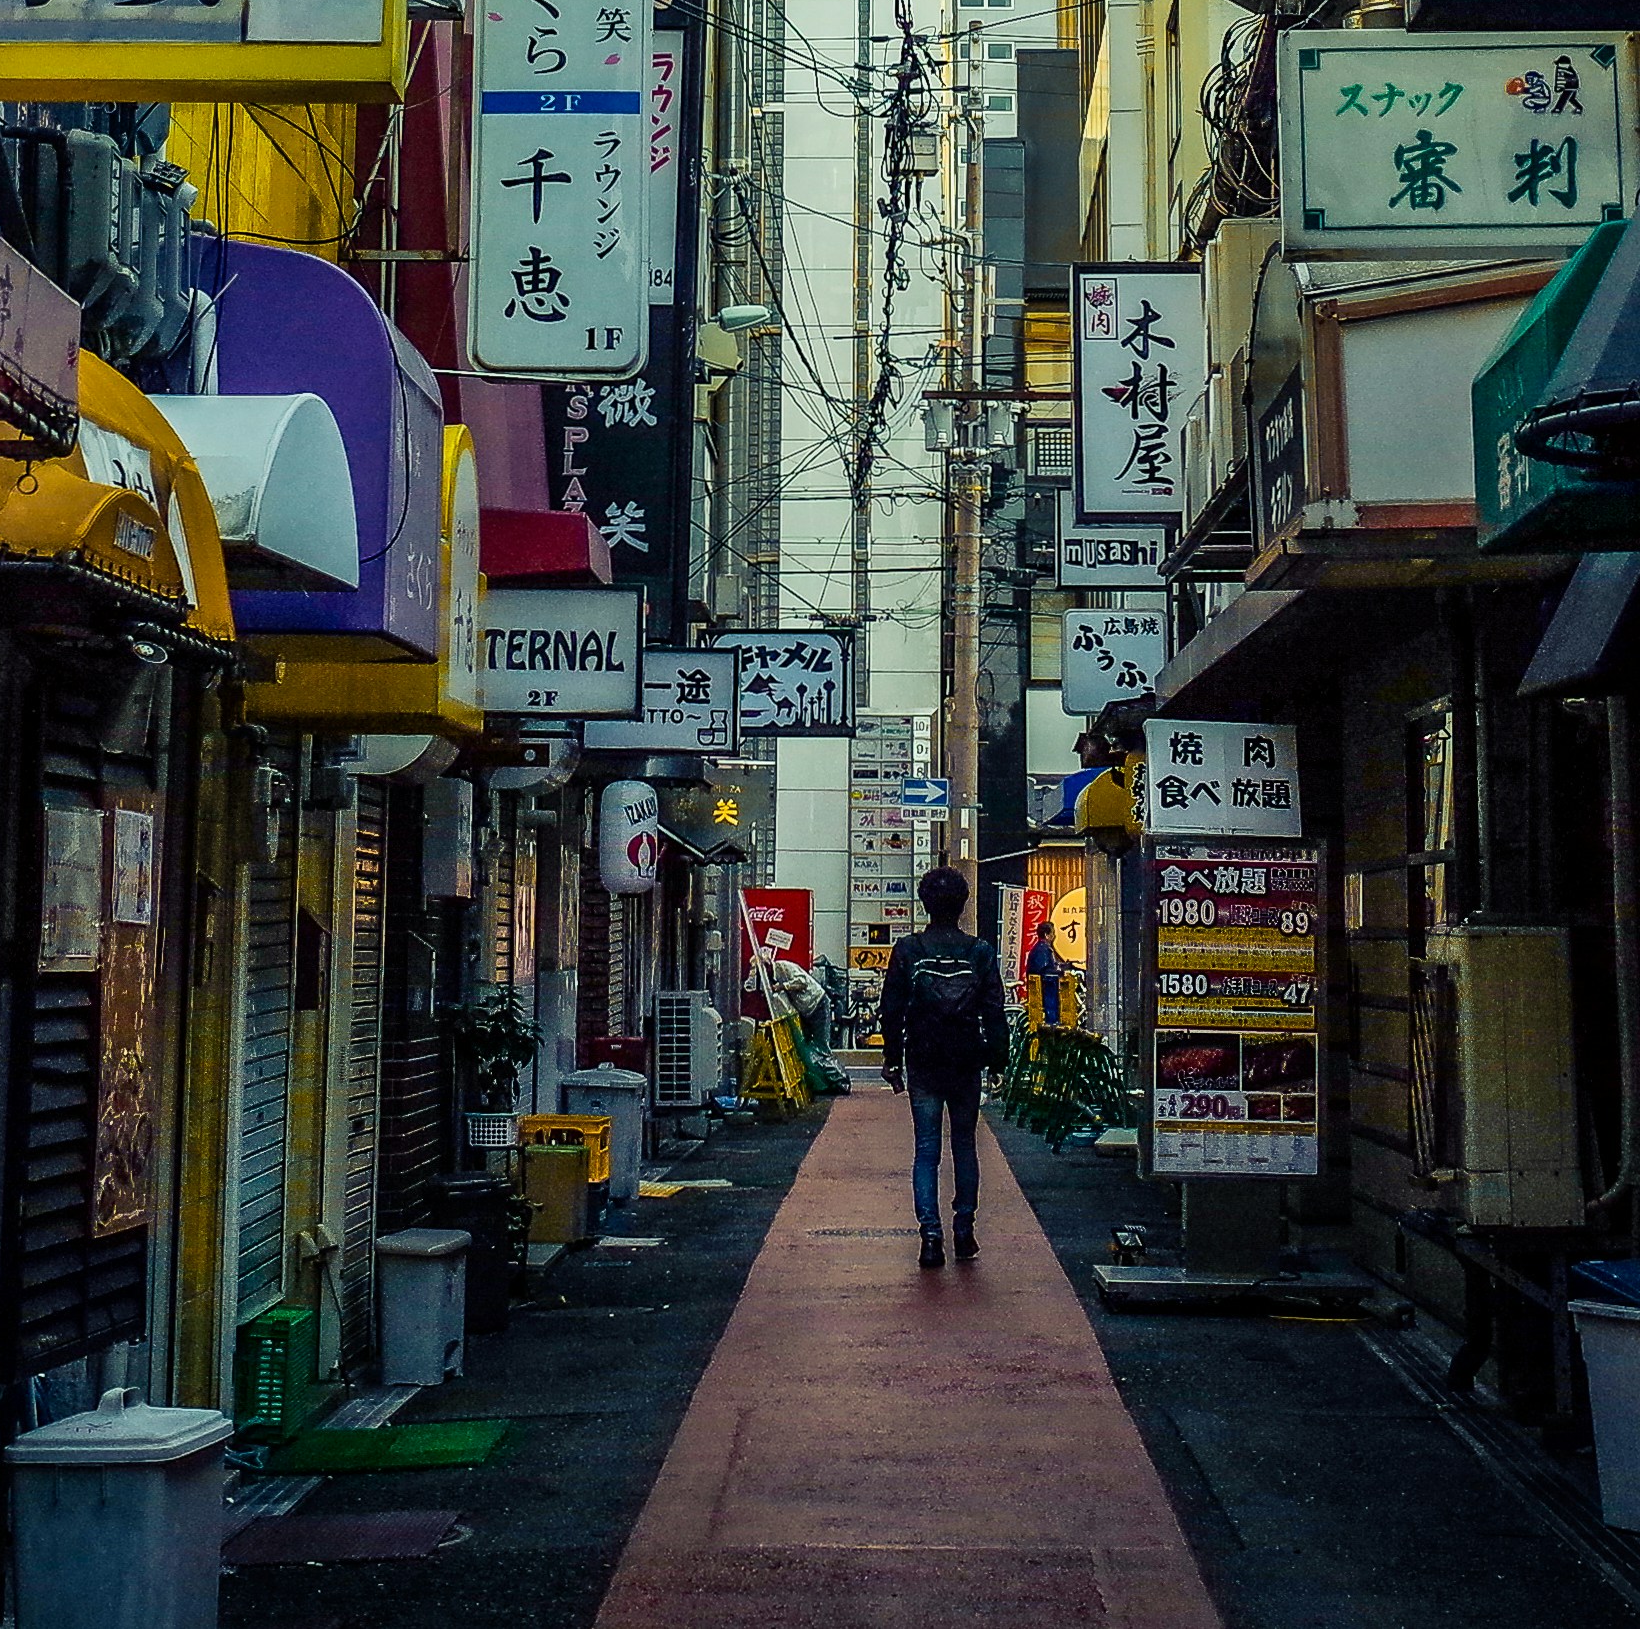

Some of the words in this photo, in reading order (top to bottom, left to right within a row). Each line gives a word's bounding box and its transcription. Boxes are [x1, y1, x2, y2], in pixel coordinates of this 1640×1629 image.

[595, 7, 632, 43] 笑
[540, 94, 581, 111] 2F
[650, 53, 673, 173] ラウンジ
[1336, 81, 1464, 118] スナック
[1389, 129, 1580, 209] 審判
[593, 131, 621, 259] ラウンジ
[501, 148, 571, 322] 千恵
[1087, 284, 1113, 335] 焼肉
[585, 327, 623, 350] 1F
[1114, 299, 1175, 486] 木村屋
[597, 378, 659, 553] 微笑
[1065, 539, 1158, 568] musashi
[1103, 617, 1160, 635] 広島焼
[527, 690, 558, 706] 2F
[644, 668, 712, 704] 一途
[1170, 731, 1276, 768] 焼肉
[1156, 774, 1292, 809] 食べ放題
[854, 884, 880, 892] RIKA
[1160, 865, 1266, 895] 食べ放題
[1159, 898, 1215, 925] 1980
[1281, 911, 1309, 935] 89
[1159, 974, 1208, 995] 1580
[1284, 983, 1311, 1004] 47
